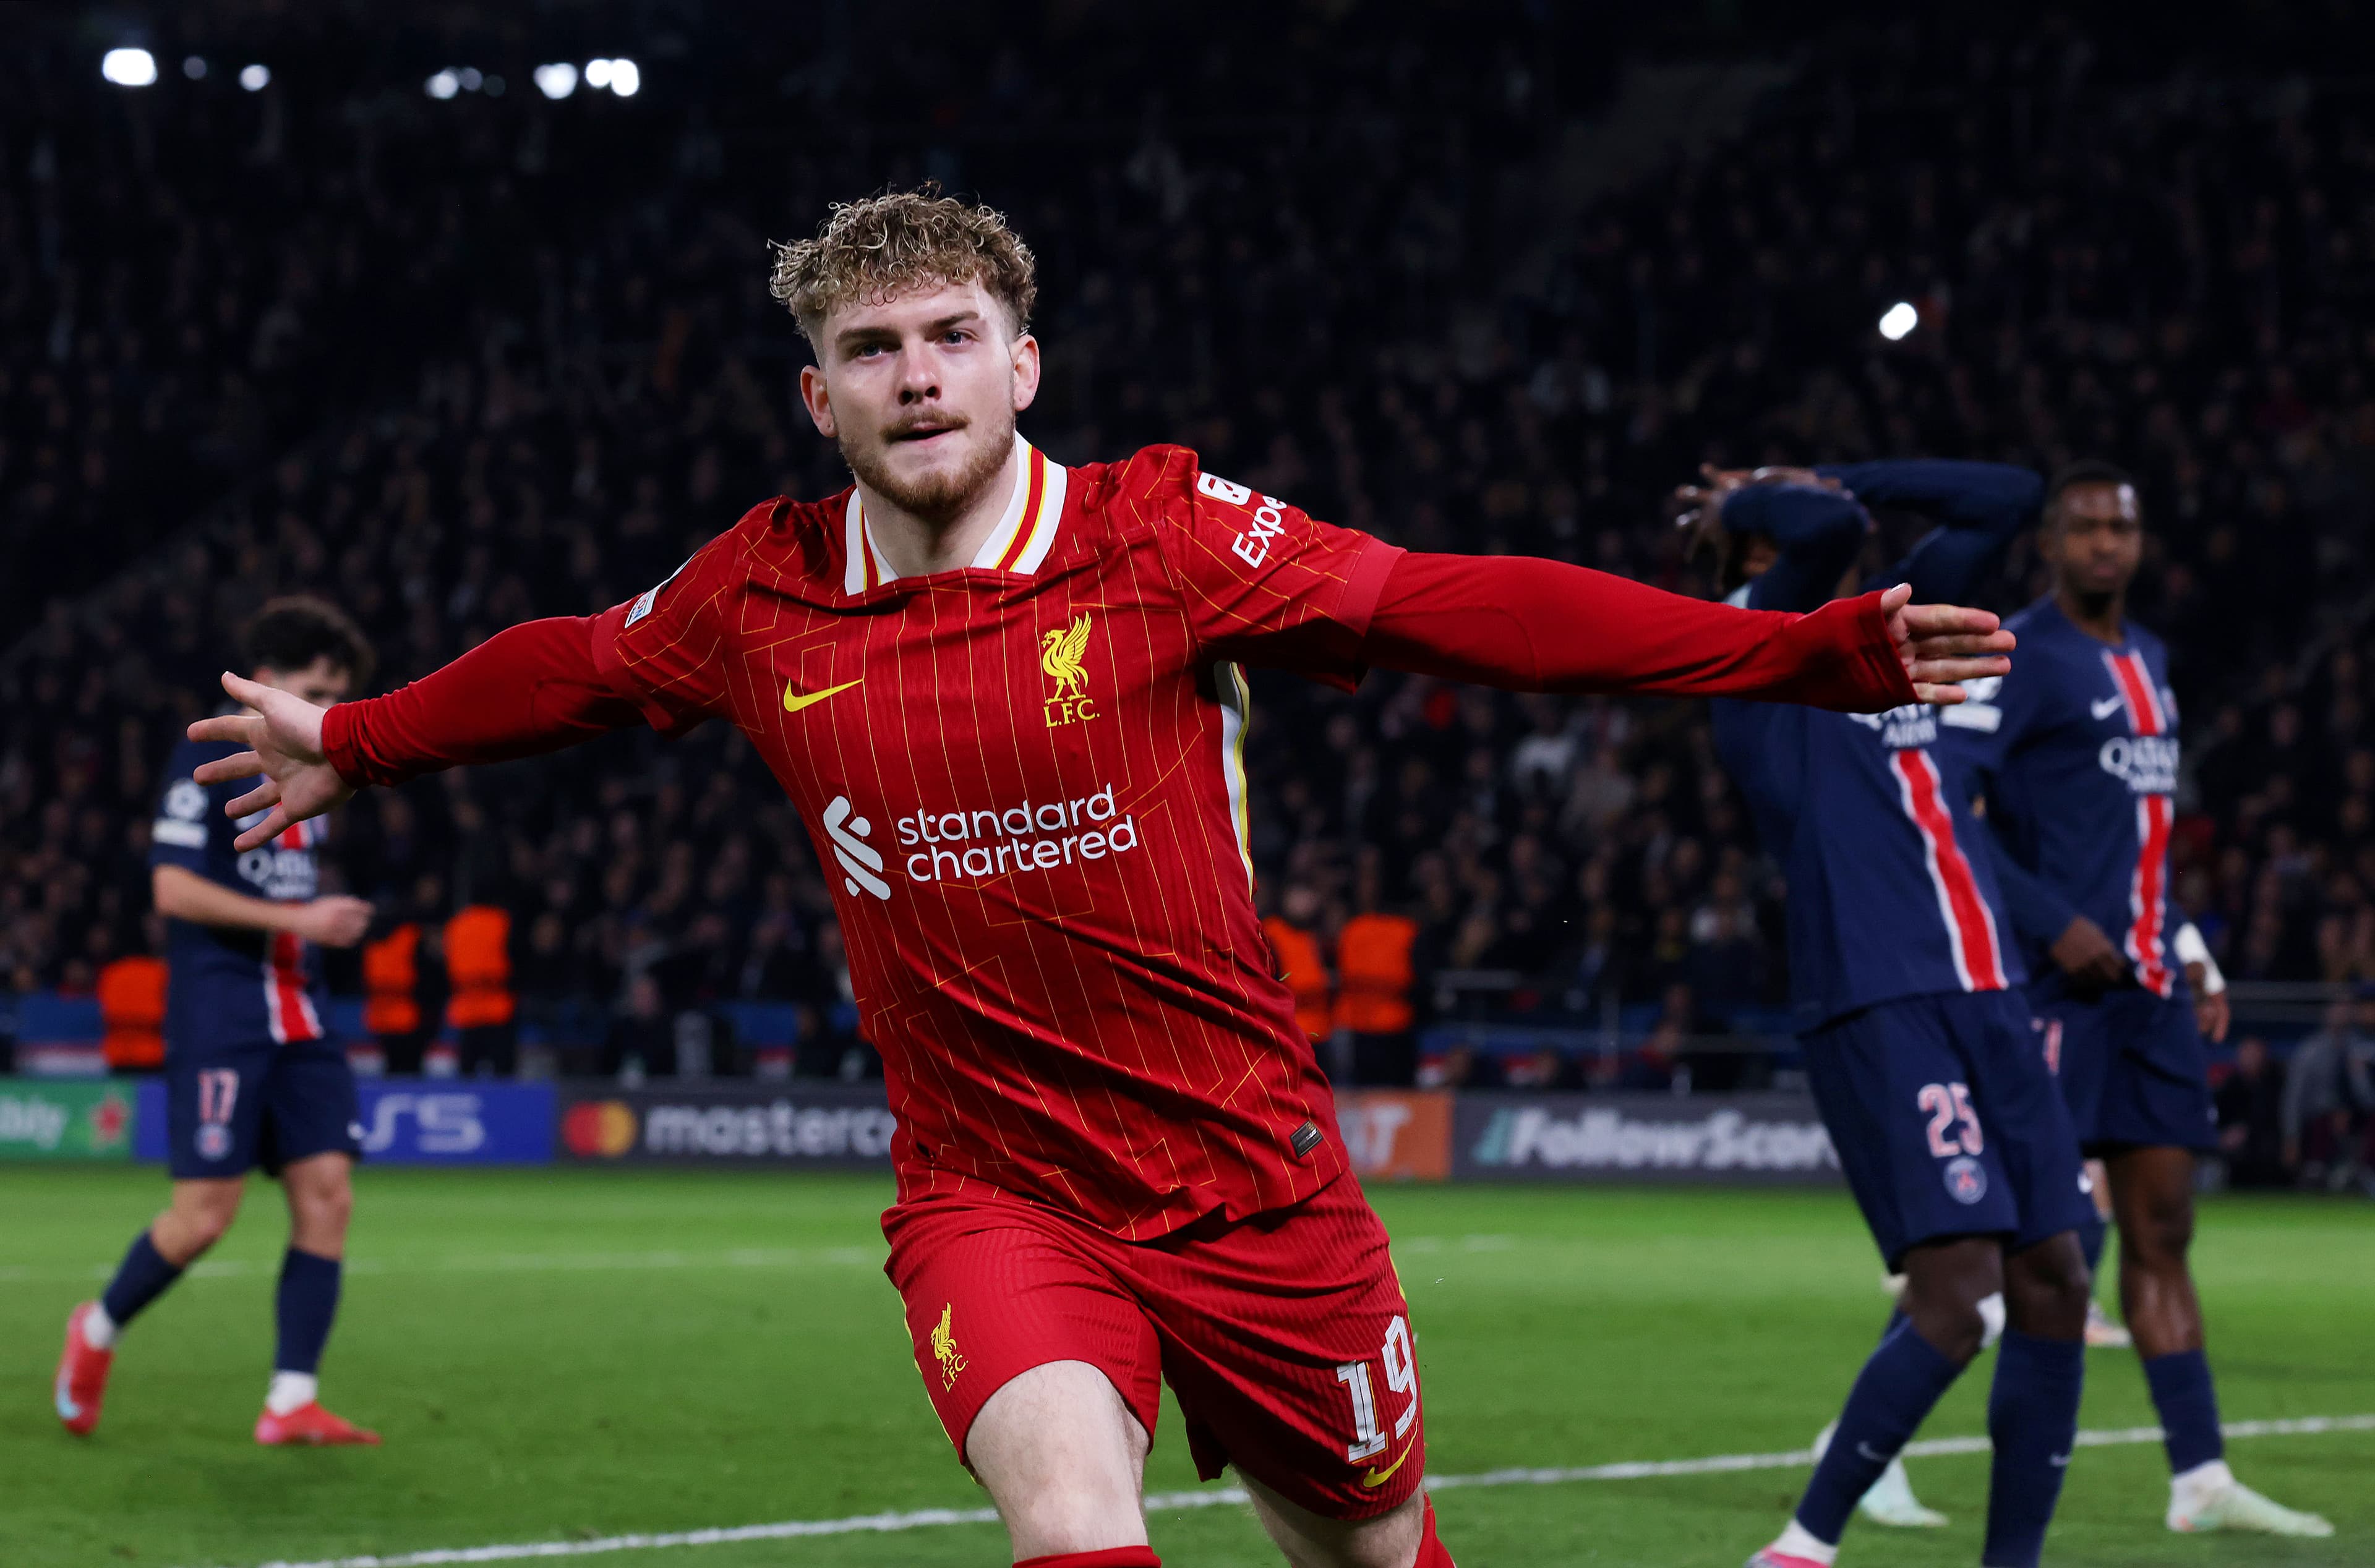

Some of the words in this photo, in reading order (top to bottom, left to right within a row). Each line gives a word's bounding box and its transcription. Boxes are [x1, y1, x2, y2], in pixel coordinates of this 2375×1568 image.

[1043, 699, 1100, 728] L.F.C.
[897, 782, 1116, 845] standard
[907, 814, 1137, 882] chartered
[197, 1068, 239, 1123] 17
[1918, 1082, 1983, 1158] 25
[1337, 1315, 1418, 1464] 19
